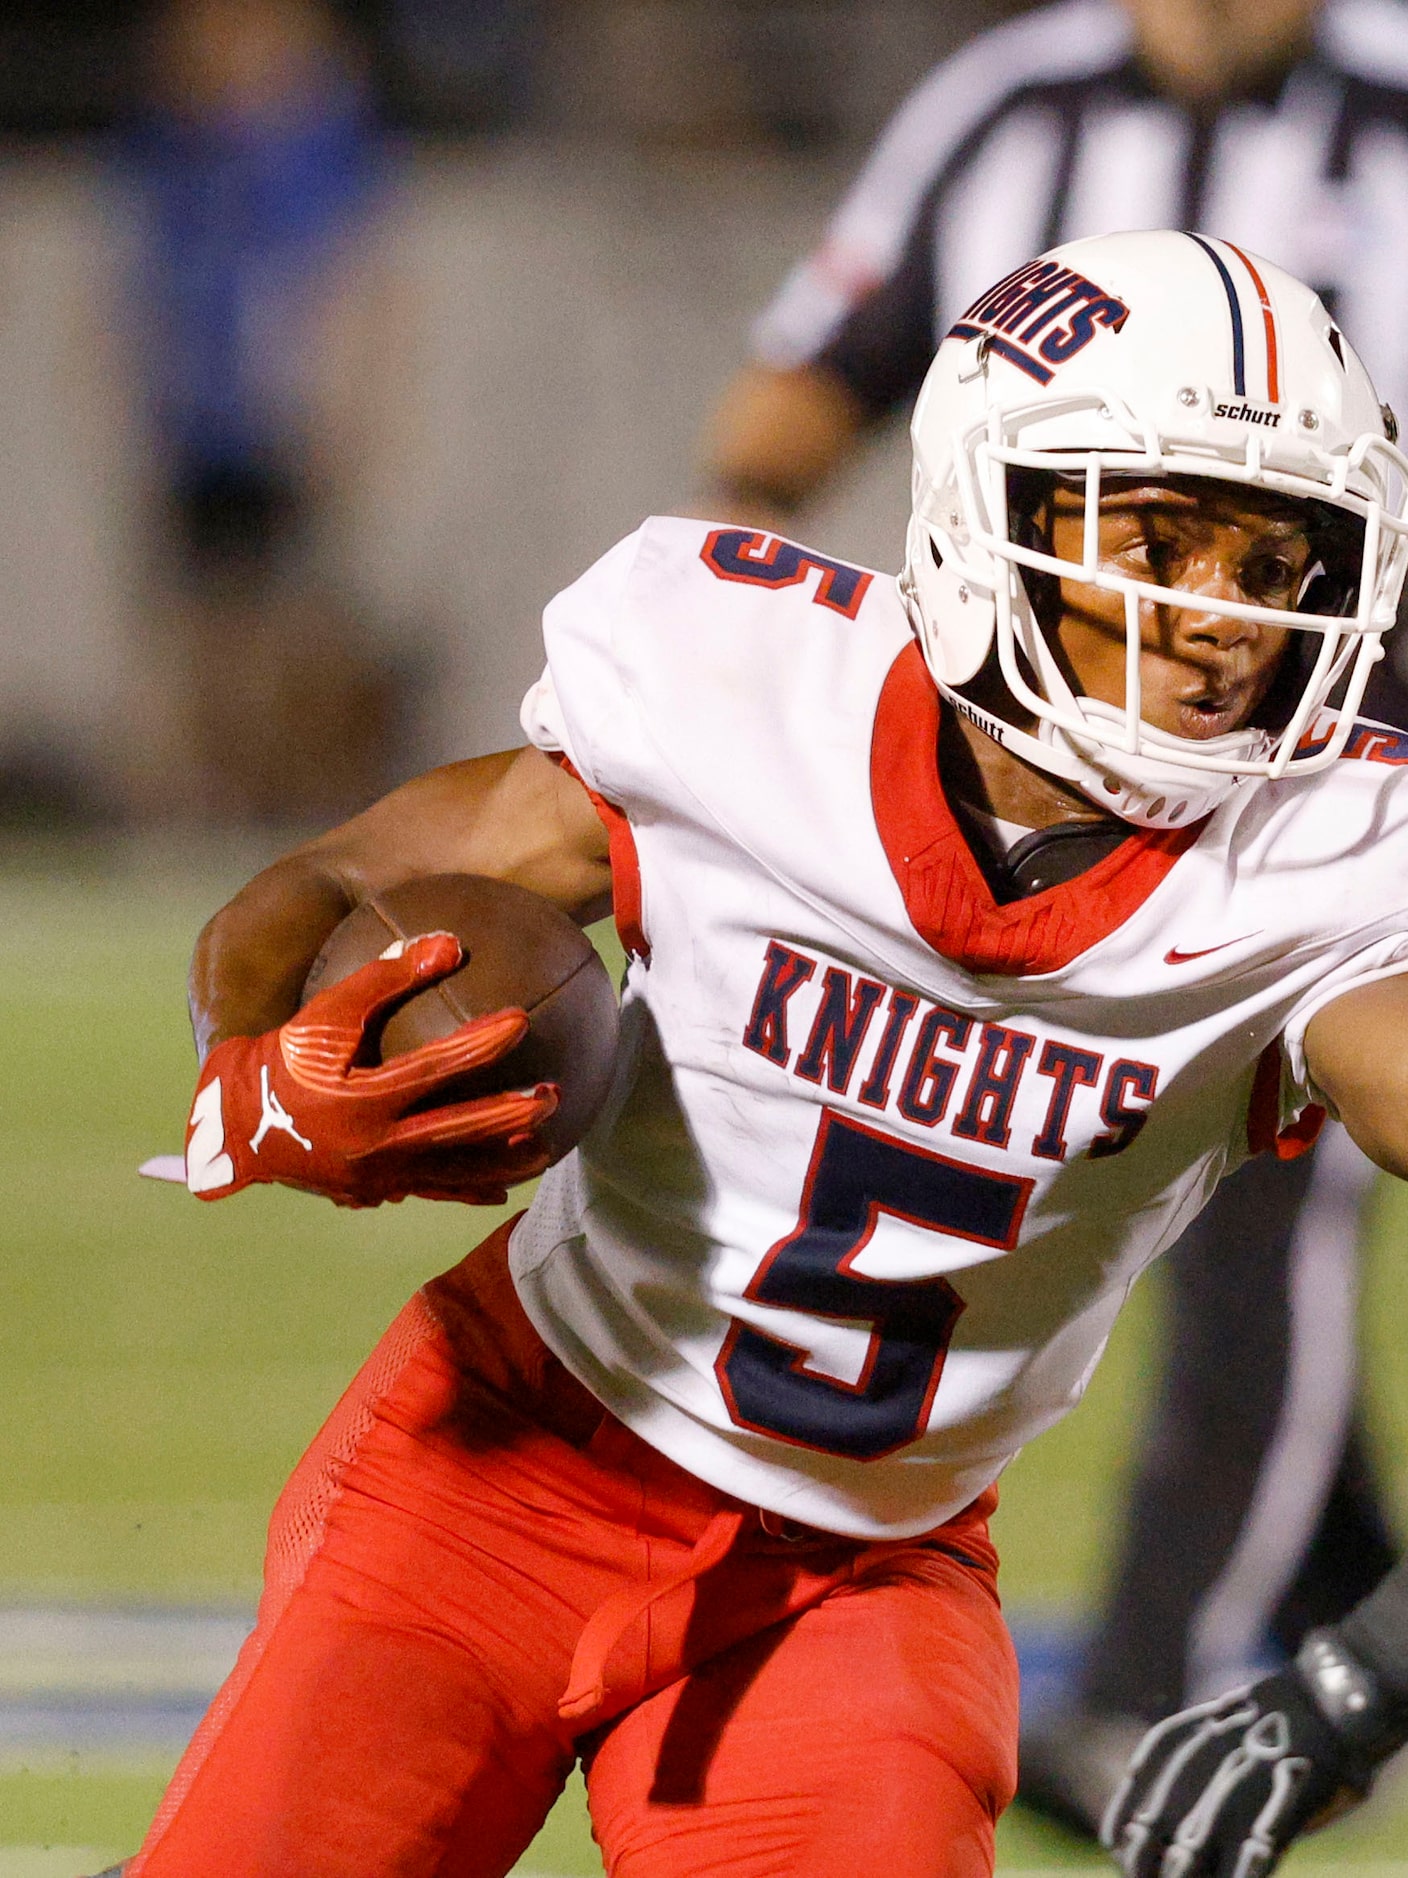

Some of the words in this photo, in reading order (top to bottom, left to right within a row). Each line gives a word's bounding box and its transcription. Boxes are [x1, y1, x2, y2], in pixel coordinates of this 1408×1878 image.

[1214, 403, 1281, 428] schutt
[698, 528, 875, 621] 5
[742, 939, 1160, 1161] KNIGHTS
[713, 1104, 1037, 1463] 5
